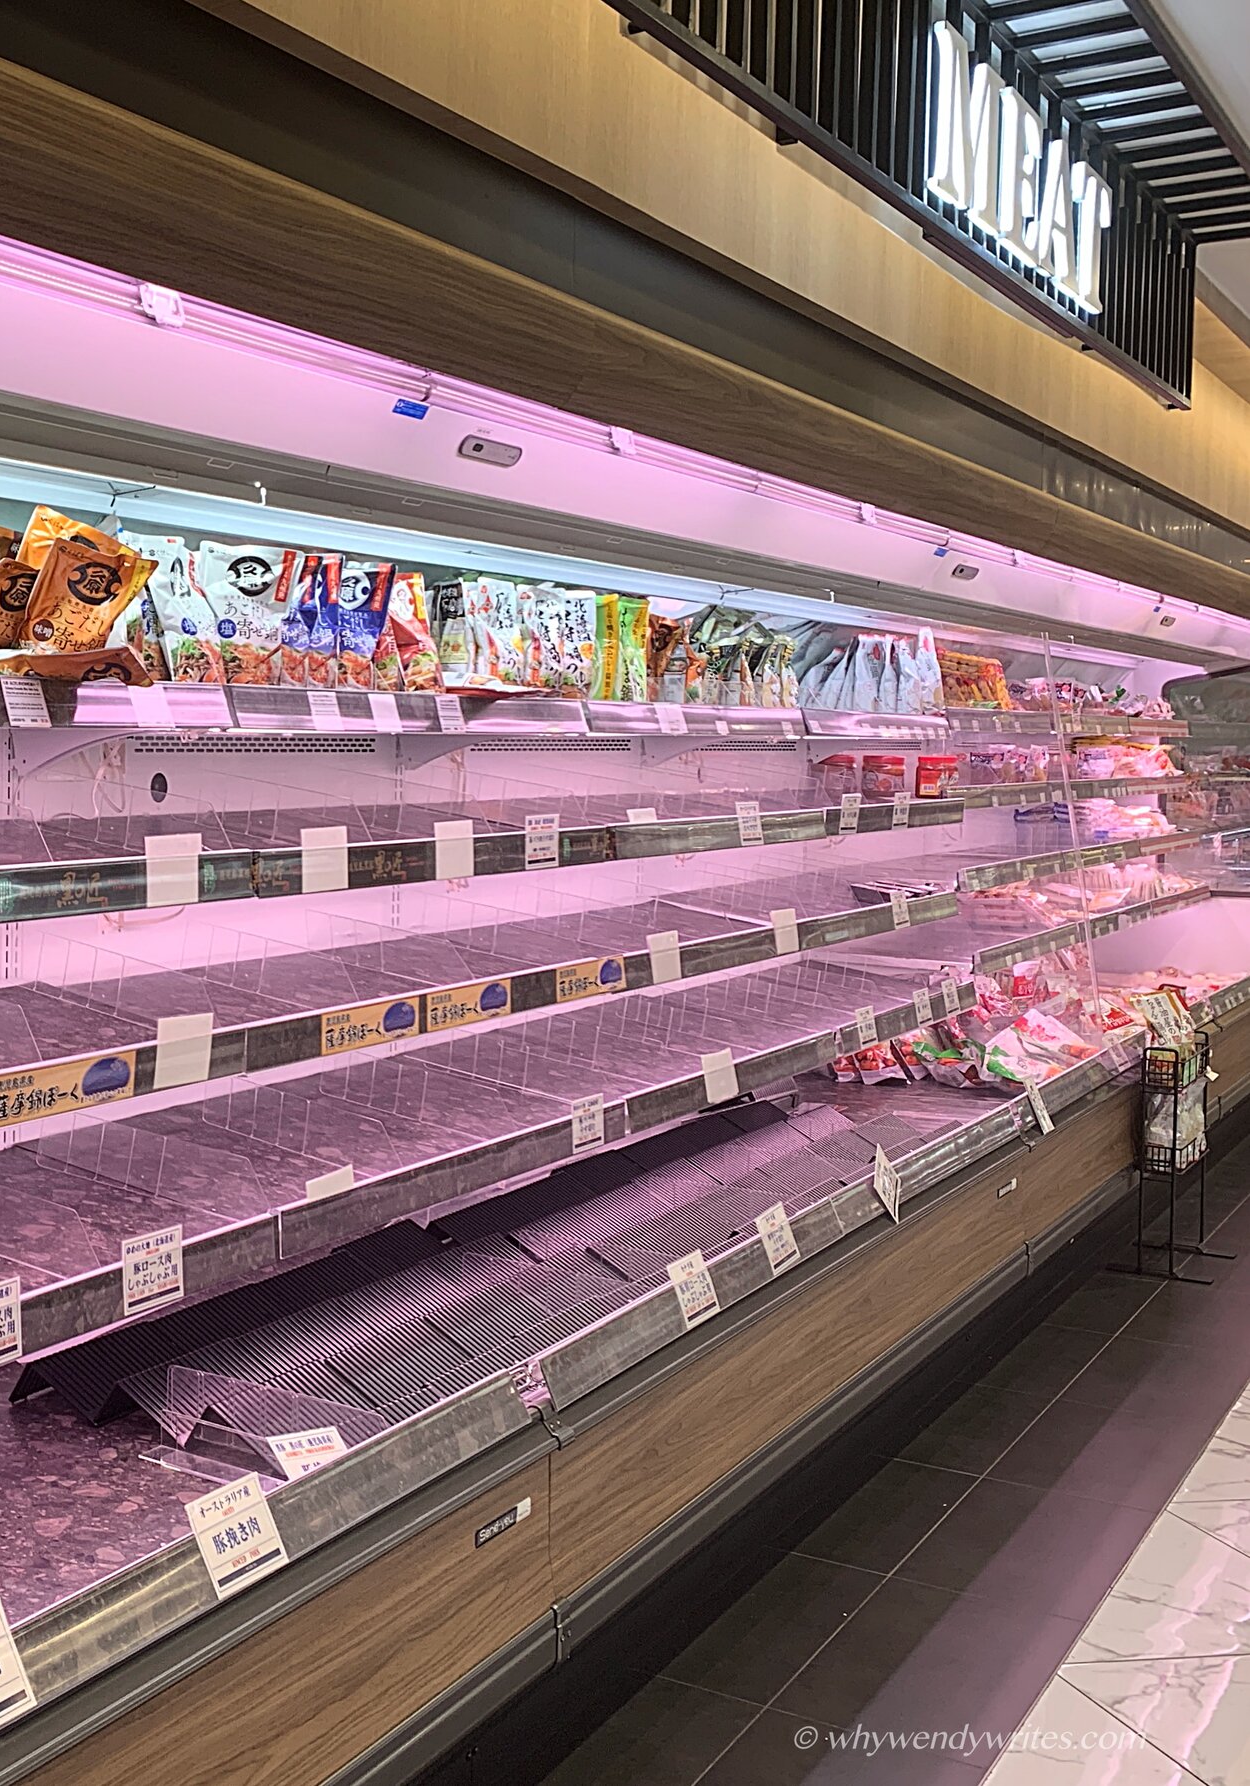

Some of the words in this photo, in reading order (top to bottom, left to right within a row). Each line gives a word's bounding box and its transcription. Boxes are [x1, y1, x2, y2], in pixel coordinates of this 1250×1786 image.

[927, 21, 1112, 314] MEAT
[48, 602, 107, 637] あごだし
[221, 620, 234, 636] 塩
[127, 1263, 178, 1291] しゃぶしゃぶ用
[133, 1252, 172, 1275] 豚ロース肉
[199, 1485, 251, 1518] オーストラリア産
[212, 1516, 262, 1555] 豚挽き肉
